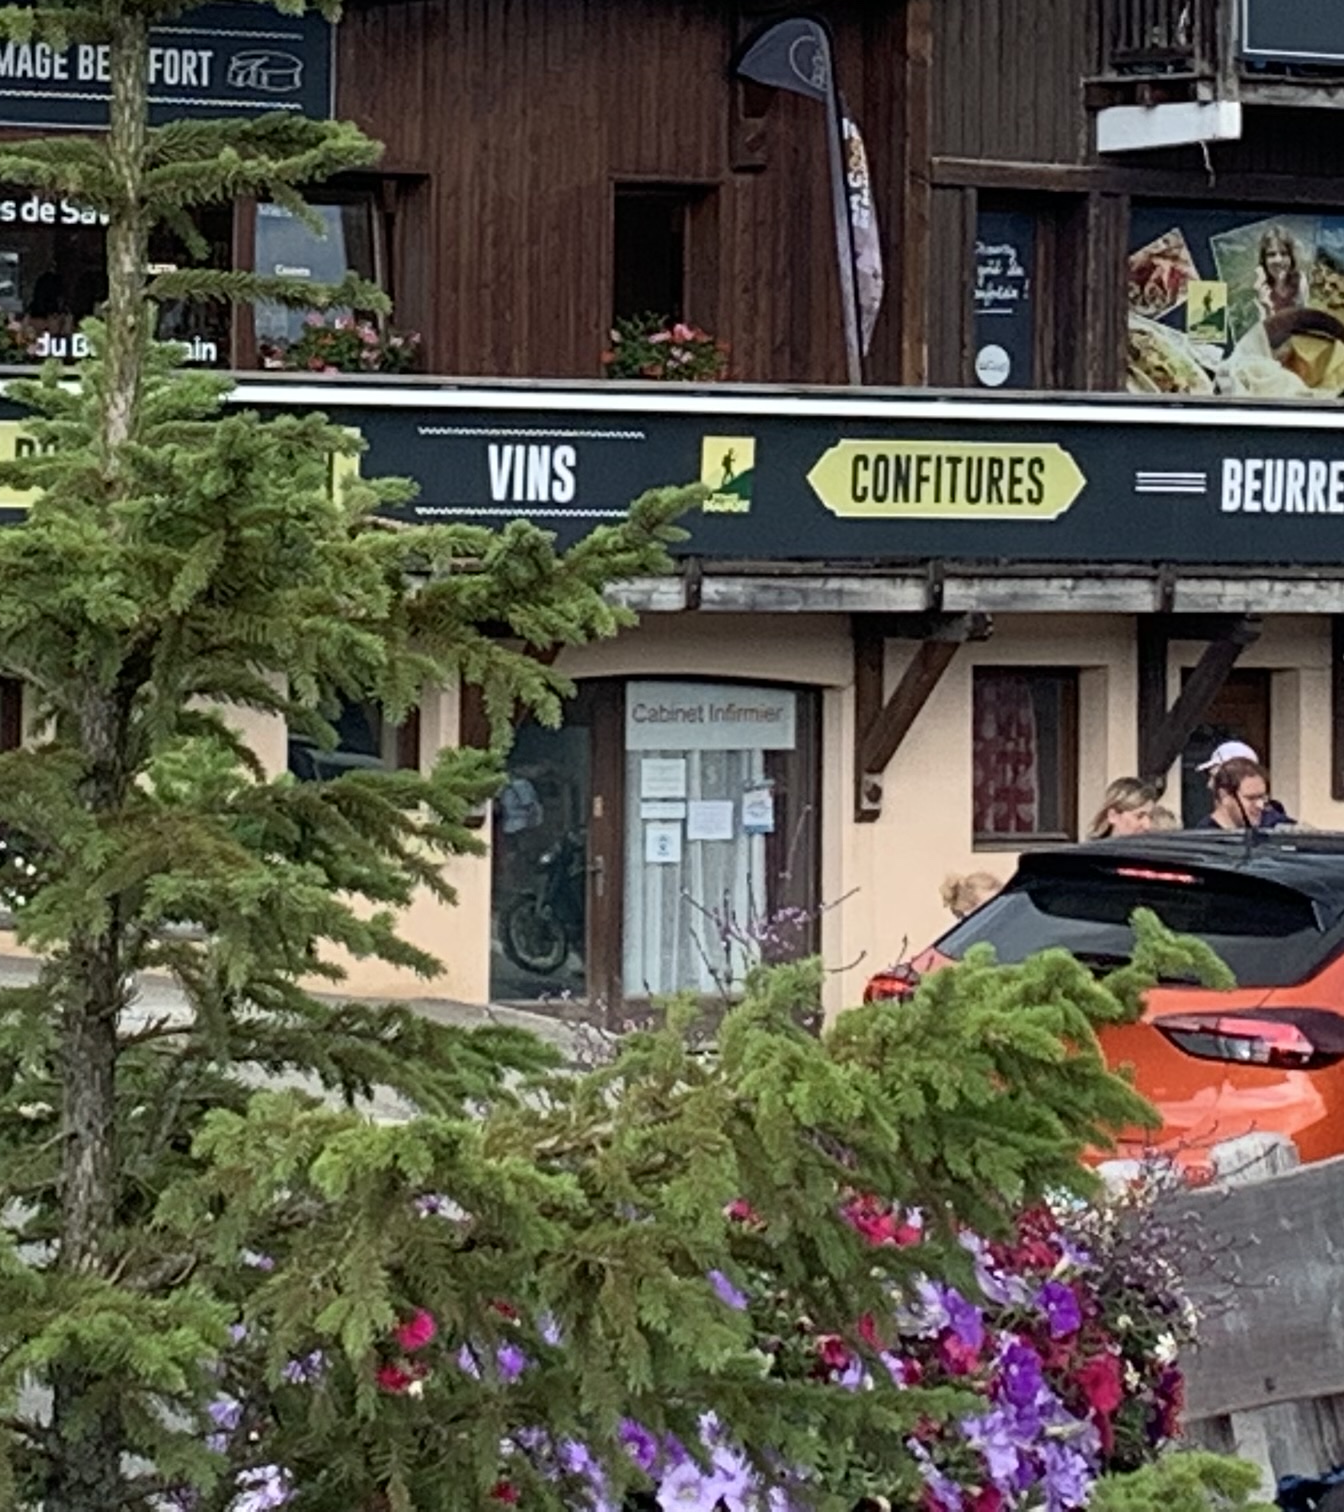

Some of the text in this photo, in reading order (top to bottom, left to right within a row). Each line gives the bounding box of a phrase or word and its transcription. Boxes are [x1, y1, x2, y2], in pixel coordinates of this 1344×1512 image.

[78, 45, 214, 87] BEFORT
[21, 195, 56, 224] de
[488, 444, 577, 504] VINS
[850, 453, 1046, 506] CONFITURES
[632, 703, 784, 724] Cabinet Infirmier
